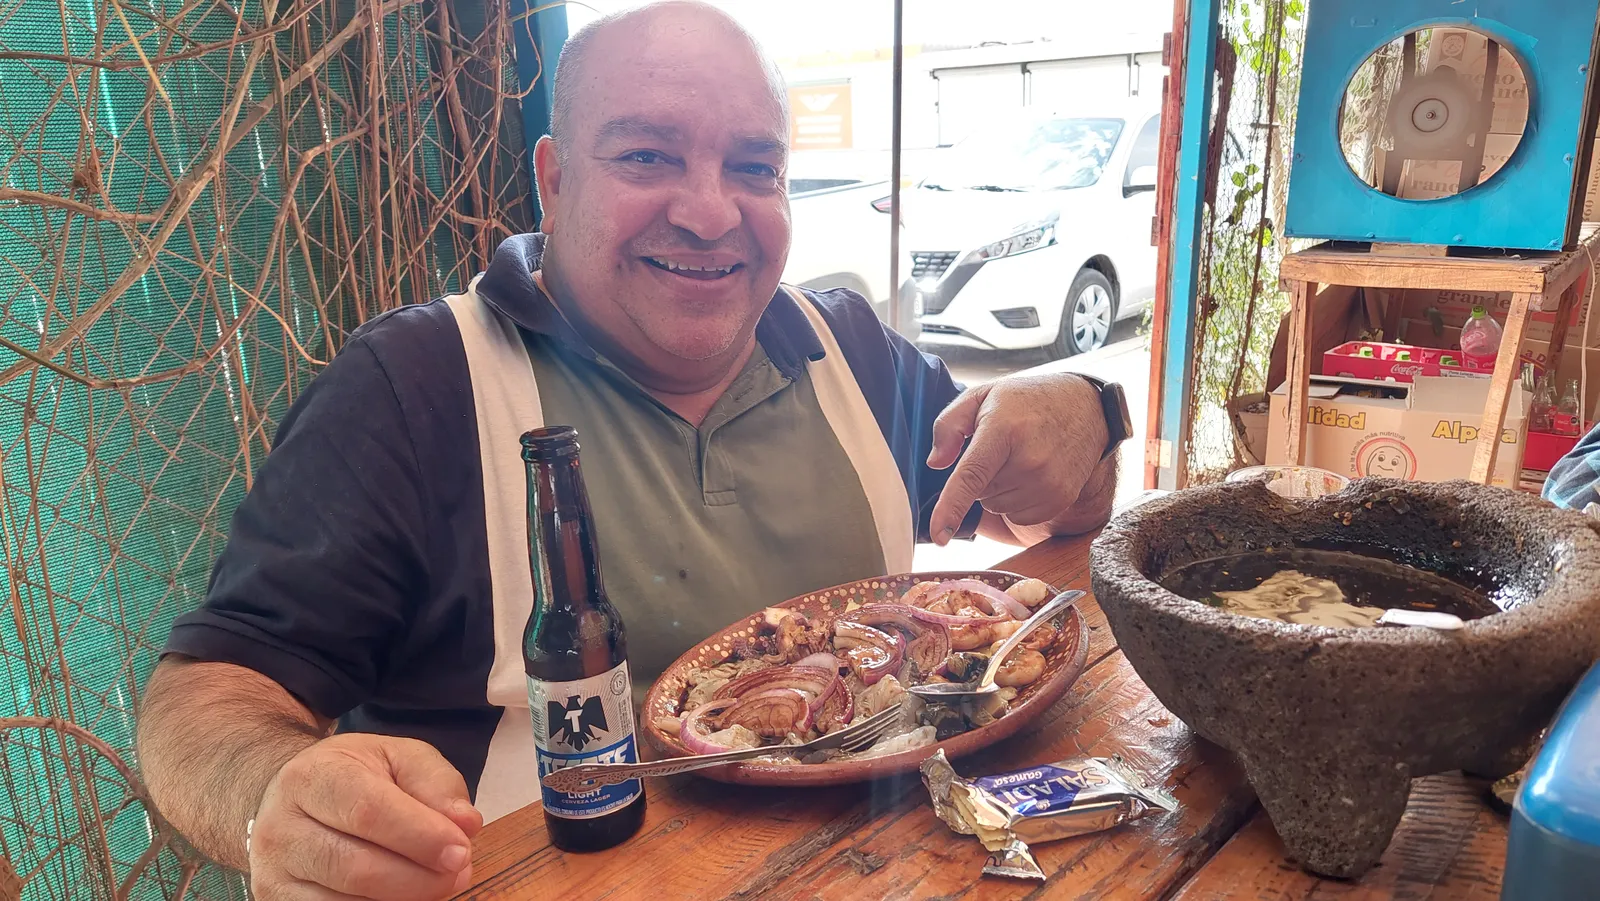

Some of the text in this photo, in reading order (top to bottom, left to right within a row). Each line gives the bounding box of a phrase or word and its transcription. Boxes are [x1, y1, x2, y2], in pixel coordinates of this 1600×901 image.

[1283, 405, 1367, 430] lidad
[1432, 420, 1518, 443] Alpa
[993, 771, 1043, 788] Gamesa
[567, 788, 602, 799] LIGHT
[590, 793, 611, 803] LAGER
